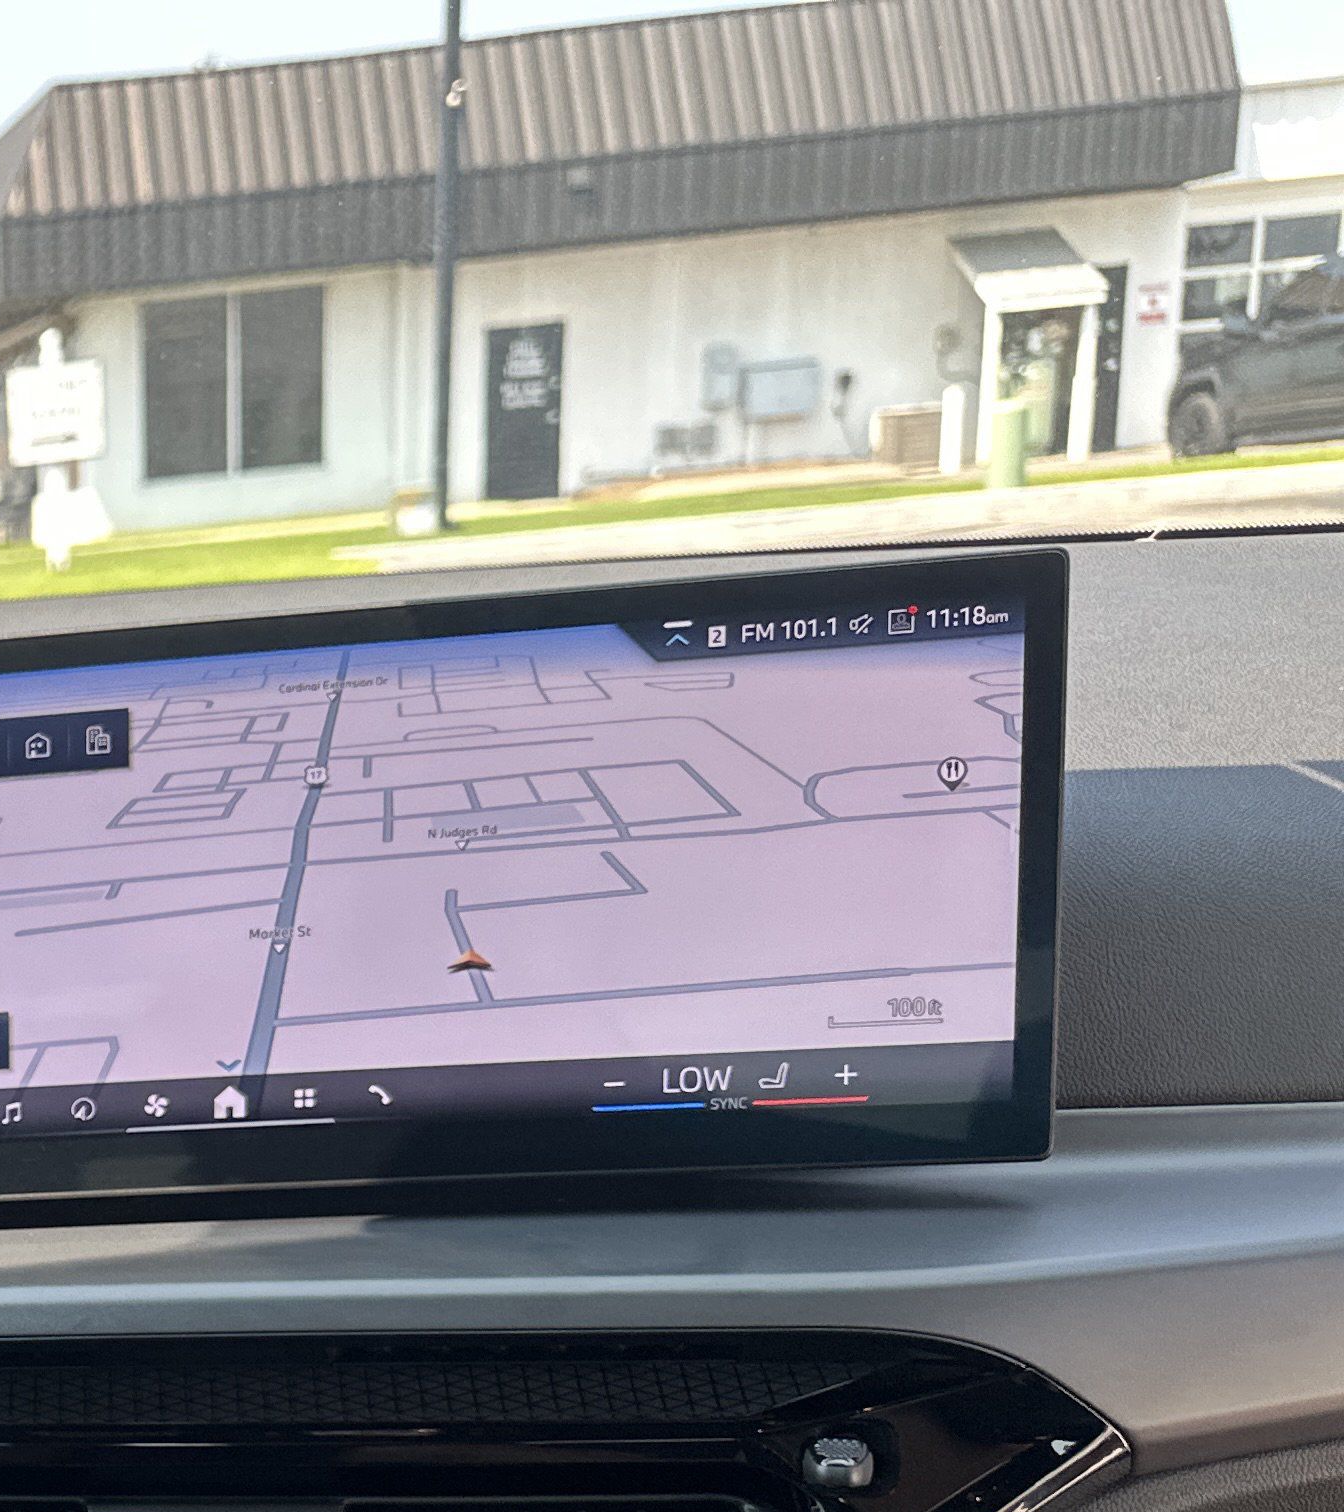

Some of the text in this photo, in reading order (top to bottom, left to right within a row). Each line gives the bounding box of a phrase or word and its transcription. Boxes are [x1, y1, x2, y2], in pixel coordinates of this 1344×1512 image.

[740, 617, 839, 643] FM 101.1
[278, 682, 321, 694] Cardinal
[323, 678, 373, 690] Extension
[310, 770, 323, 780] 17
[427, 825, 498, 840] N Judges Rd
[249, 926, 312, 940] Market St
[887, 996, 944, 1018] 100 ft
[662, 1066, 734, 1093] LOW
[710, 1096, 748, 1111] SYNC
